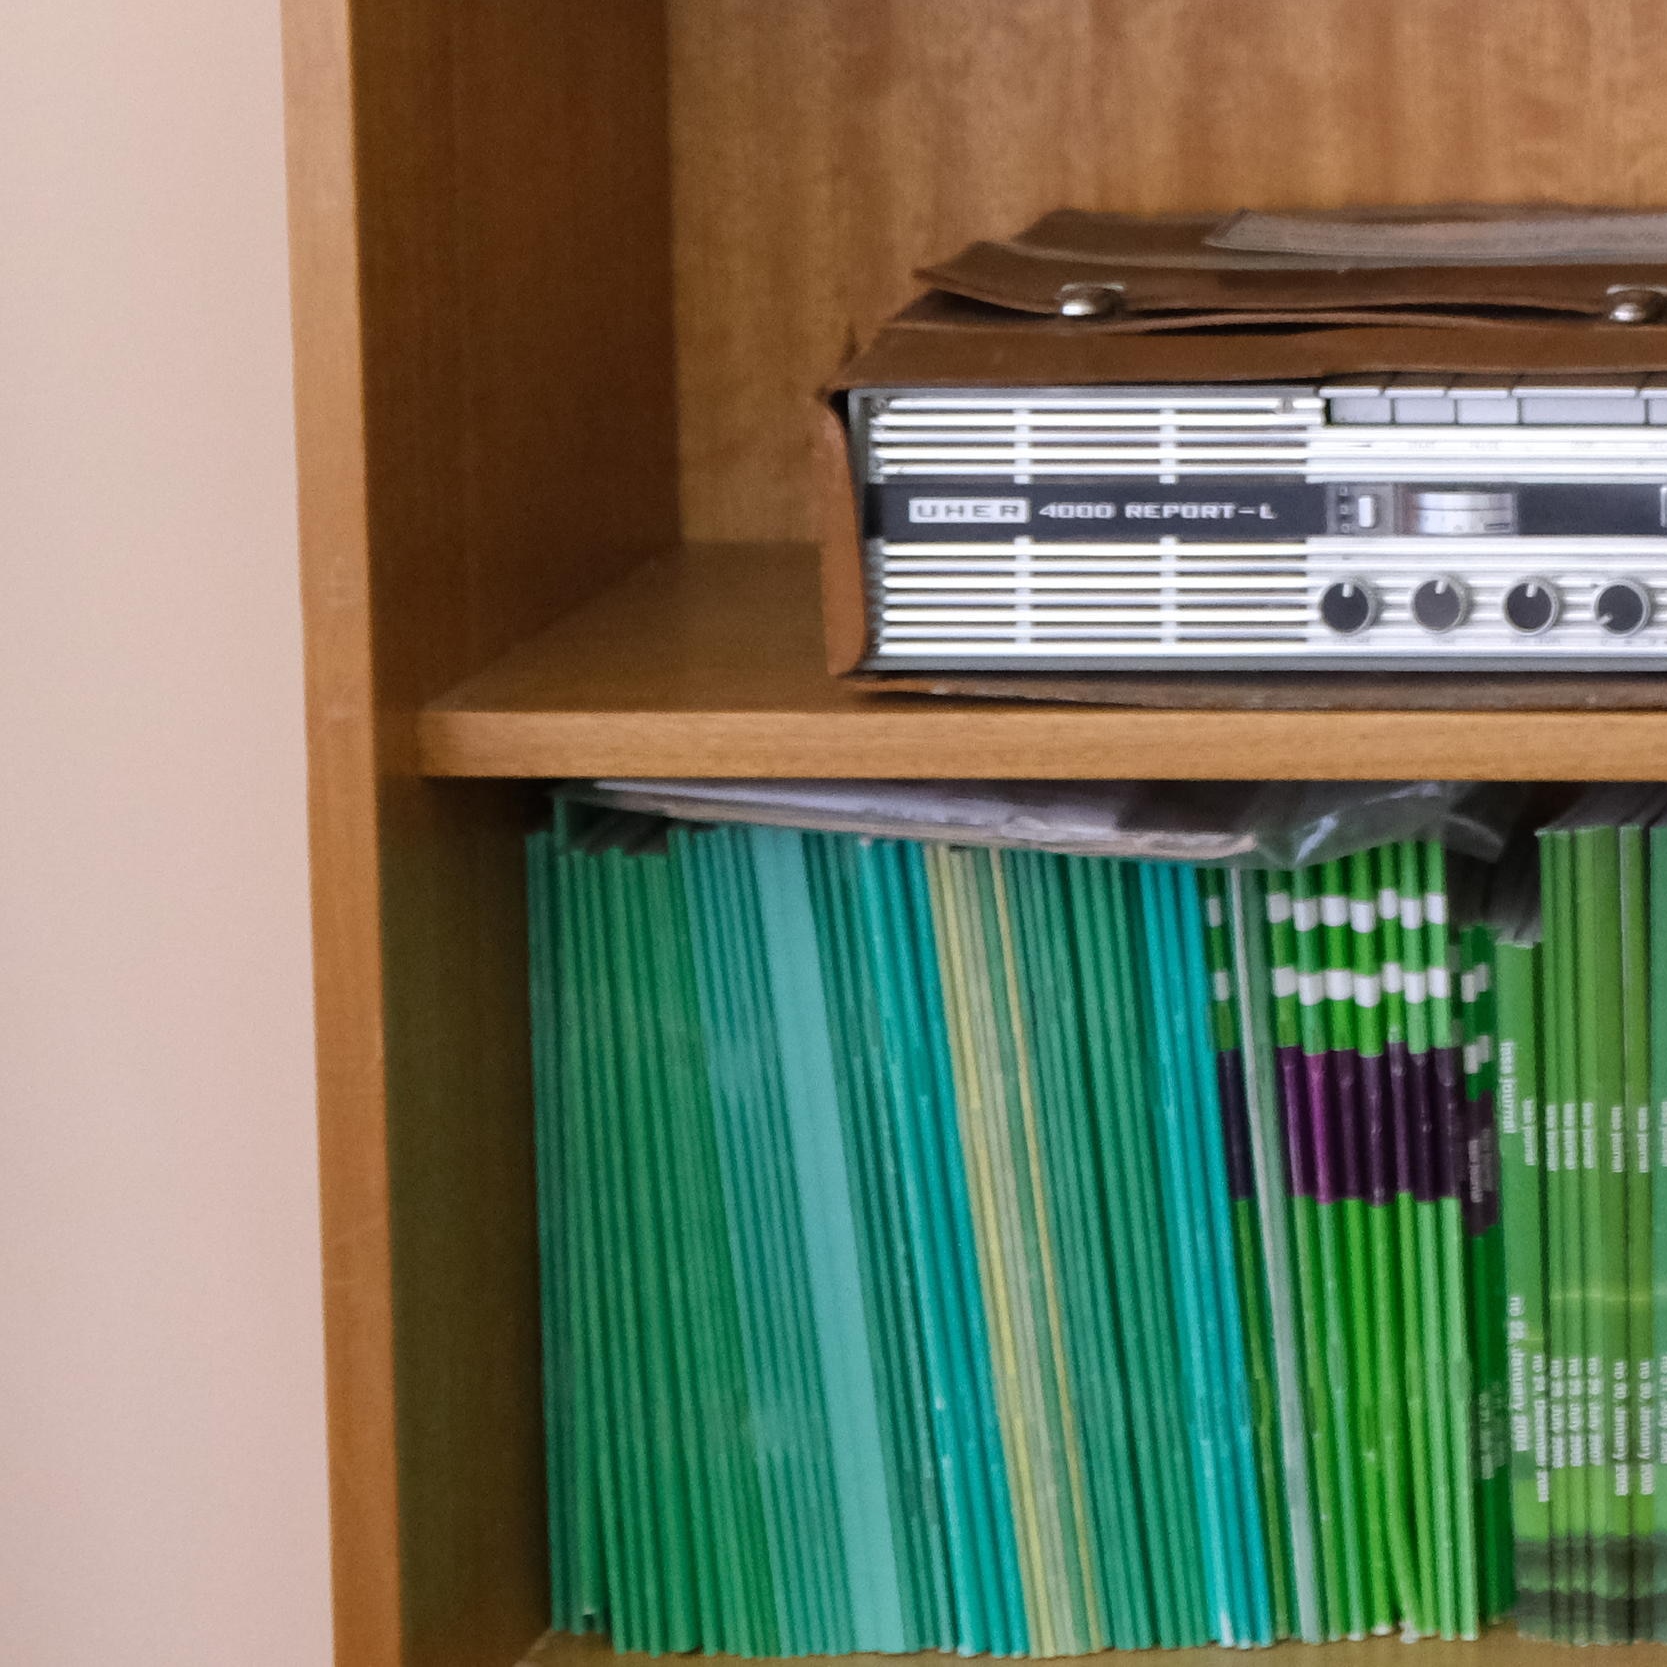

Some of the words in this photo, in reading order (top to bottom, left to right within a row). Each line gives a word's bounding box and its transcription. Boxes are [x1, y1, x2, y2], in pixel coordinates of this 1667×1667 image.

[916, 504, 1020, 519] UHER
[1039, 502, 1117, 519] 4000
[1125, 502, 1278, 520] REPORT-L
[1498, 1078, 1517, 1134] journal
[1509, 1297, 1524, 1316] no
[1533, 1355, 1545, 1372] no
[1614, 1361, 1626, 1380] no
[1639, 1361, 1651, 1379] no
[1510, 1349, 1526, 1410] January
[1513, 1414, 1528, 1451] 2004
[1535, 1400, 1547, 1466] December
[1612, 1406, 1628, 1460] January
[1637, 1406, 1653, 1459] January
